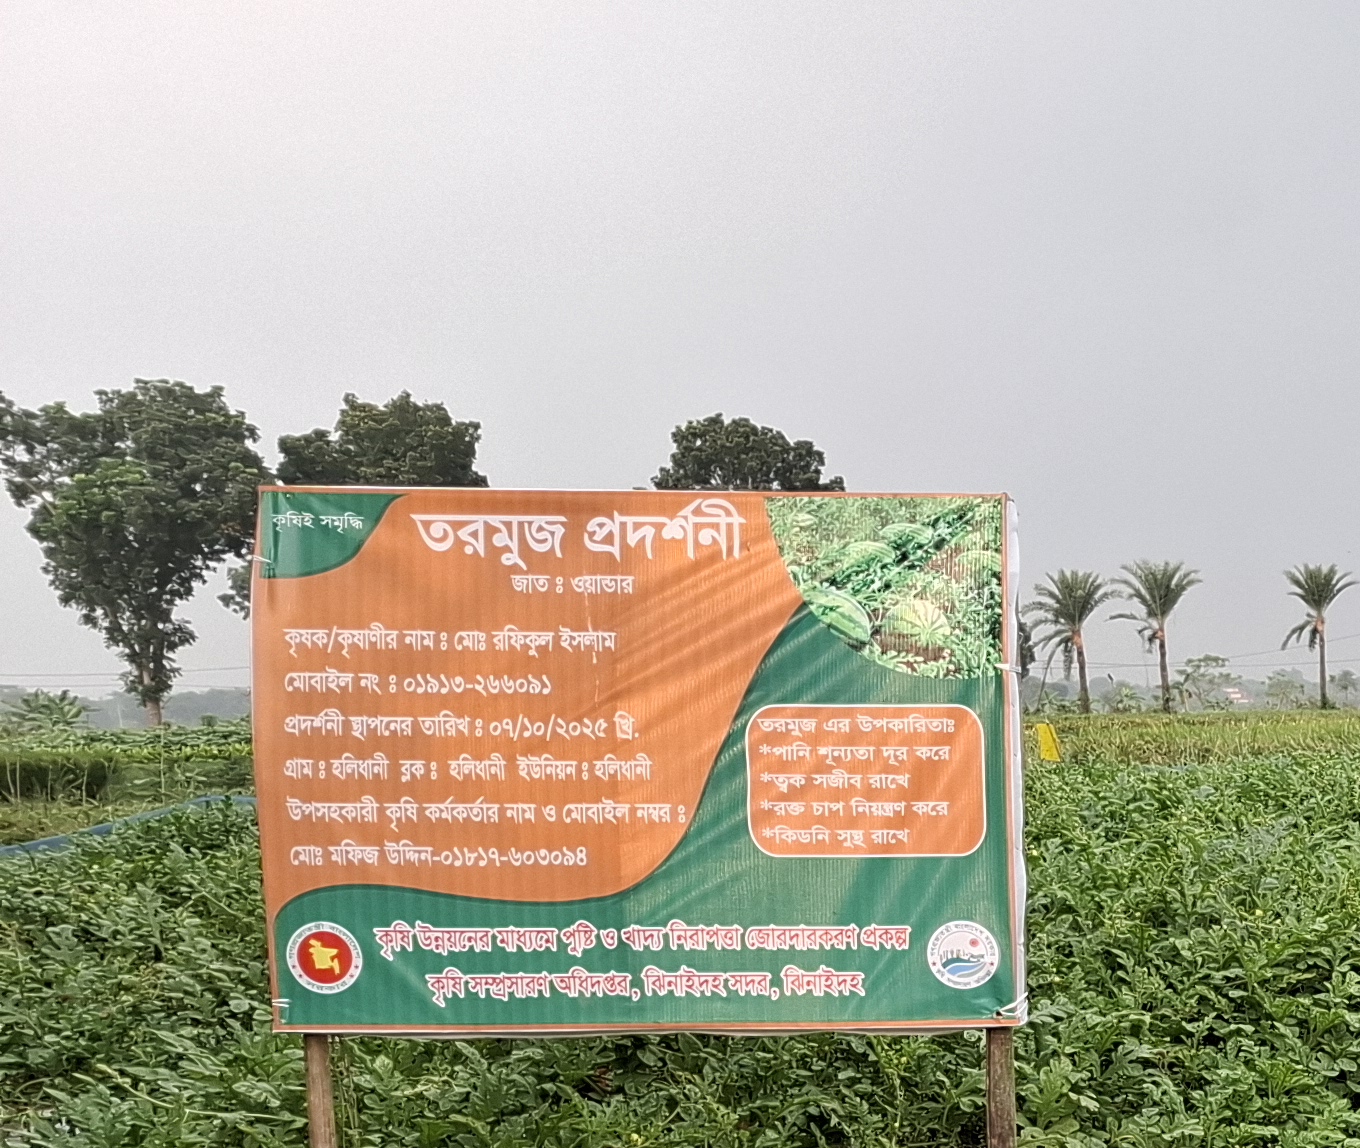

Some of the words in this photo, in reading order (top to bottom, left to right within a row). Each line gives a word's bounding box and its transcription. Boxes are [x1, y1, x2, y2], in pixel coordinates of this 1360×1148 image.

[410, 513, 568, 570] তরমুজ
[584, 498, 746, 561] প্রদর্শনী
[511, 574, 550, 594] জাত
[571, 574, 634, 595] ওয়ান্ডার
[283, 622, 398, 658] কৃষক/কৃষাণীর
[403, 631, 435, 651] নাম
[492, 625, 555, 657] রফিকুল
[560, 626, 616, 652] ইসলাম
[285, 666, 354, 694] মোবাইল
[359, 673, 380, 693] নং
[404, 673, 551, 696] ০১৯১৩-২৬৬০৯১
[284, 709, 346, 737] প্রদর্শনী
[348, 714, 414, 741] স্থাপনের
[418, 709, 471, 737] তারিখ
[489, 713, 608, 741] ০৭/১০/২০২৫
[758, 718, 817, 737] তরমুজ
[823, 718, 852, 733] এর
[284, 758, 315, 778] গ্রাম
[330, 753, 389, 780] হলিধানী
[400, 759, 425, 782] ব্লক
[448, 753, 506, 781] হলিধানী
[517, 754, 578, 781] ইউনিয়ন
[594, 753, 652, 781] হলিধানী
[817, 746, 875, 765] শূন্যতা
[880, 746, 909, 766] দূর
[914, 746, 951, 761] করে
[811, 769, 864, 789] সজীব
[867, 773, 910, 789] রাখে
[286, 797, 379, 824] উপসহকারী
[385, 797, 419, 832] কৃষি
[424, 796, 500, 824] কর্মকর্তার
[505, 803, 536, 824] নাম
[542, 805, 556, 823] ও
[563, 797, 628, 824] মোবাইল
[635, 804, 671, 824] নম্বর
[811, 801, 845, 816] চাপ
[911, 801, 949, 816] করে
[870, 829, 909, 845] রাখে
[328, 840, 380, 867] মফিজ
[373, 921, 413, 961] কৃষি
[415, 920, 492, 956] উন্নয়নের
[493, 926, 558, 952] মাধ্যমে
[560, 920, 596, 957] পুষ্টি
[600, 928, 617, 950] ও
[621, 925, 663, 951] খাদ্য
[666, 919, 743, 951] নিরাপত্তা
[745, 924, 859, 951] জোরদারকরণ
[860, 925, 911, 950] প্রকল্প
[425, 967, 465, 1006] কৃষি
[466, 971, 552, 1001] সম্প্রসারণ
[641, 965, 727, 997] ঝিনাইদহ
[781, 965, 865, 997] ঝিনাইদহ
